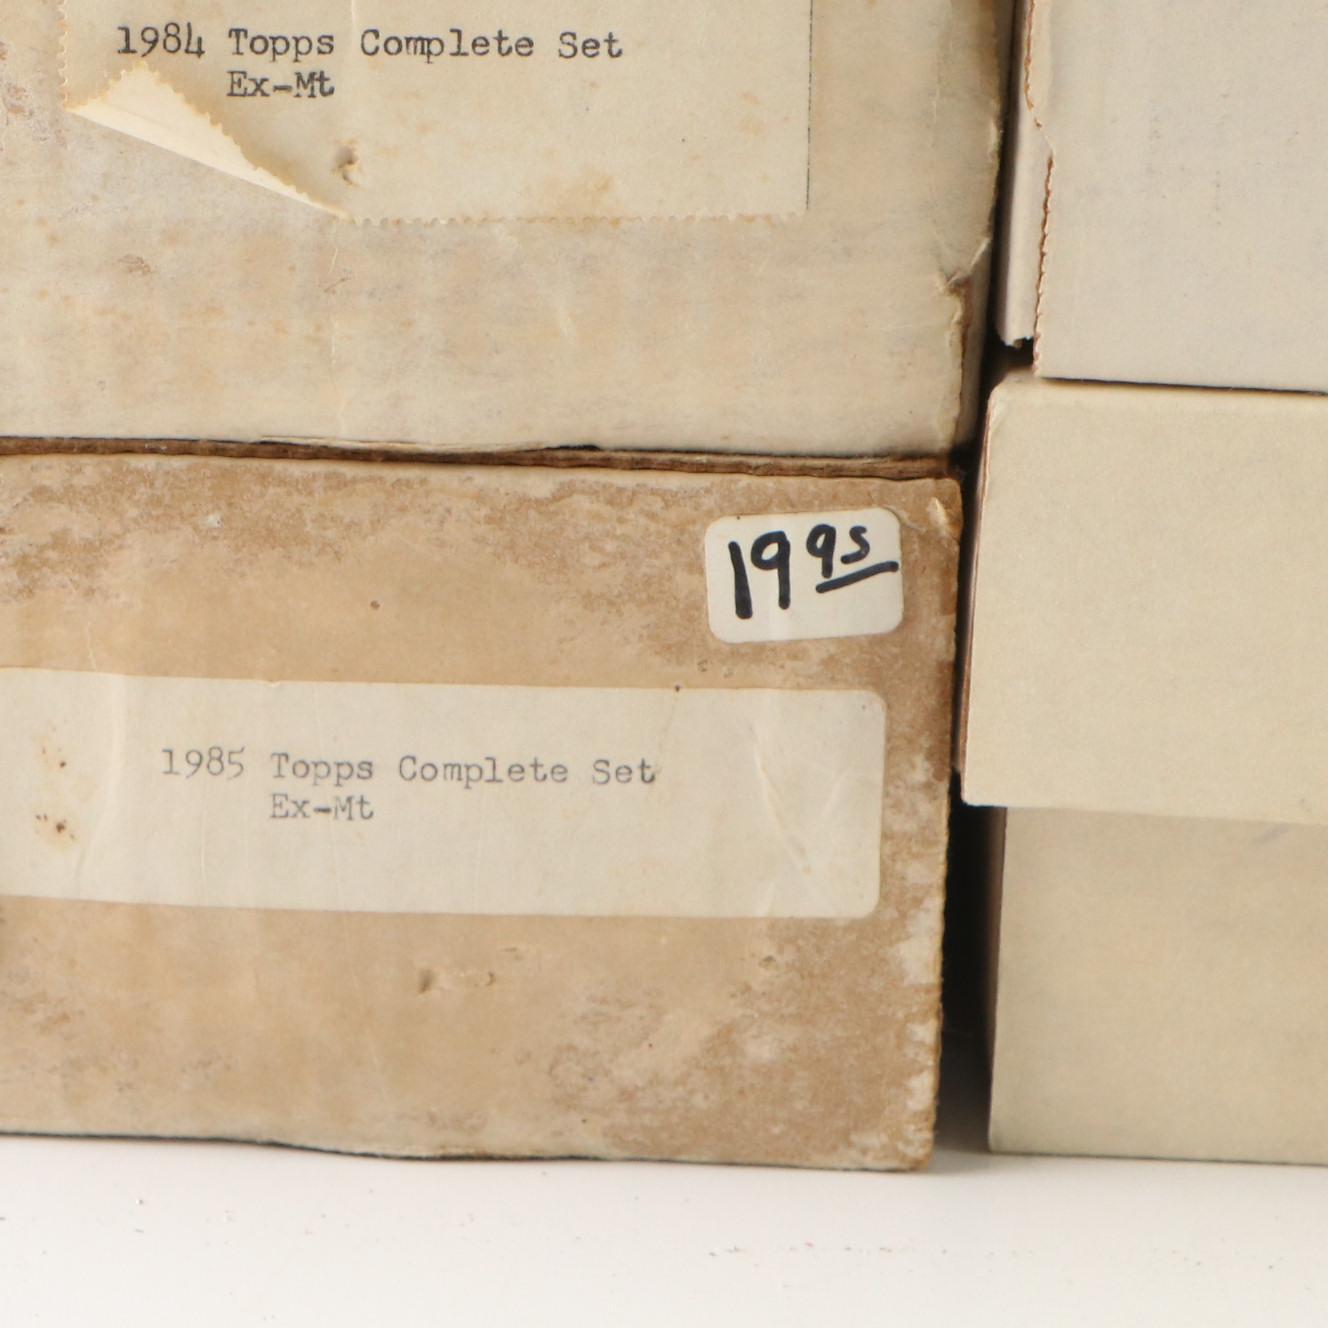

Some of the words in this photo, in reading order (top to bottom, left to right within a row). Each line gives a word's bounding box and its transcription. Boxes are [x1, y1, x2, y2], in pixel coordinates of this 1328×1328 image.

[116, 23, 207, 58] 1984
[227, 28, 336, 63] Topps
[360, 28, 536, 64] Complete
[557, 32, 624, 59] Set
[226, 70, 336, 98] Ex-Mt
[161, 747, 246, 780] 1985
[270, 752, 375, 788] Topps
[398, 755, 569, 792] Complete
[592, 758, 657, 785] Set
[269, 793, 376, 823] Ex-Mt
